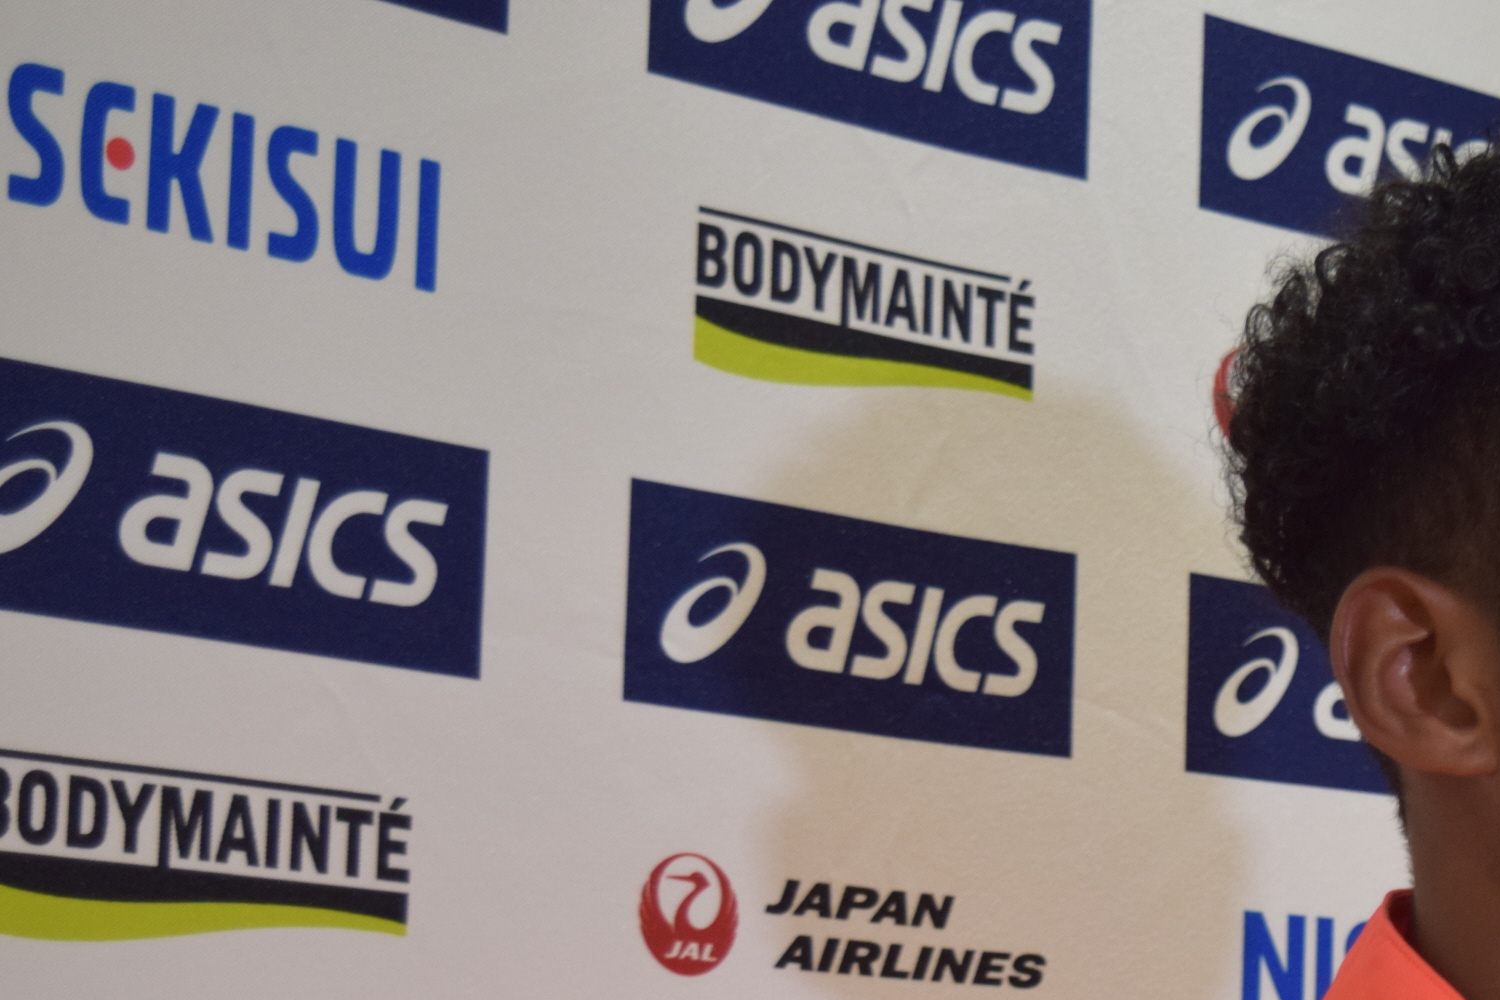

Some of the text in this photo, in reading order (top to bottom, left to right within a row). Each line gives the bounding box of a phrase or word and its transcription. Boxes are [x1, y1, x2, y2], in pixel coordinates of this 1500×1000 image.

[7, 62, 441, 293] SEKISUI
[695, 220, 1036, 357] BODYMAINTÉ
[119, 452, 449, 607] asics
[786, 568, 1046, 697] asics
[663, 940, 718, 962] JAL
[765, 879, 955, 930] JAPAN
[774, 935, 1047, 990] AIRLINES
